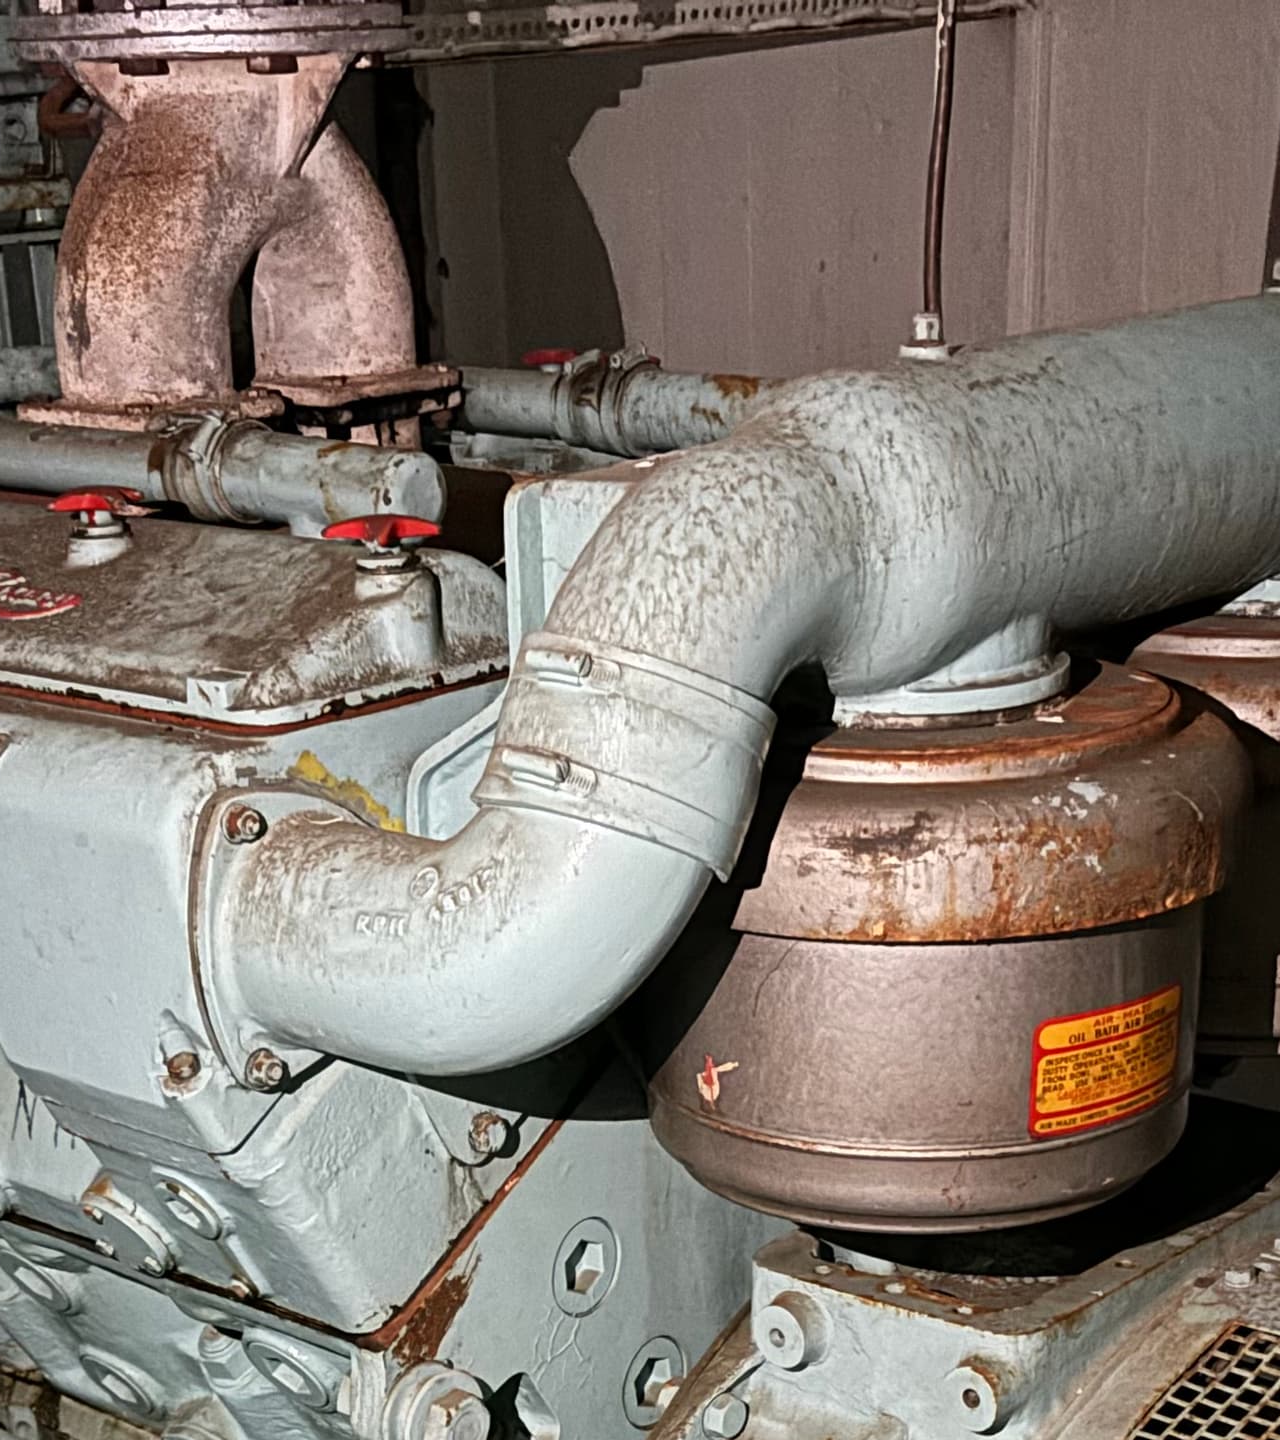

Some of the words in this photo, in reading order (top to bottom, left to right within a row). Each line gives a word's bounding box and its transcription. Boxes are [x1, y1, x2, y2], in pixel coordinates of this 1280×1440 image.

[1068, 1032, 1085, 1044] OIL
[1095, 1024, 1120, 1039] BATH
[1124, 1017, 1141, 1030] AIR
[1045, 1054, 1079, 1066] INSPECT
[1043, 1066, 1068, 1076] DUSTY
[1042, 1075, 1066, 1084] FROM
